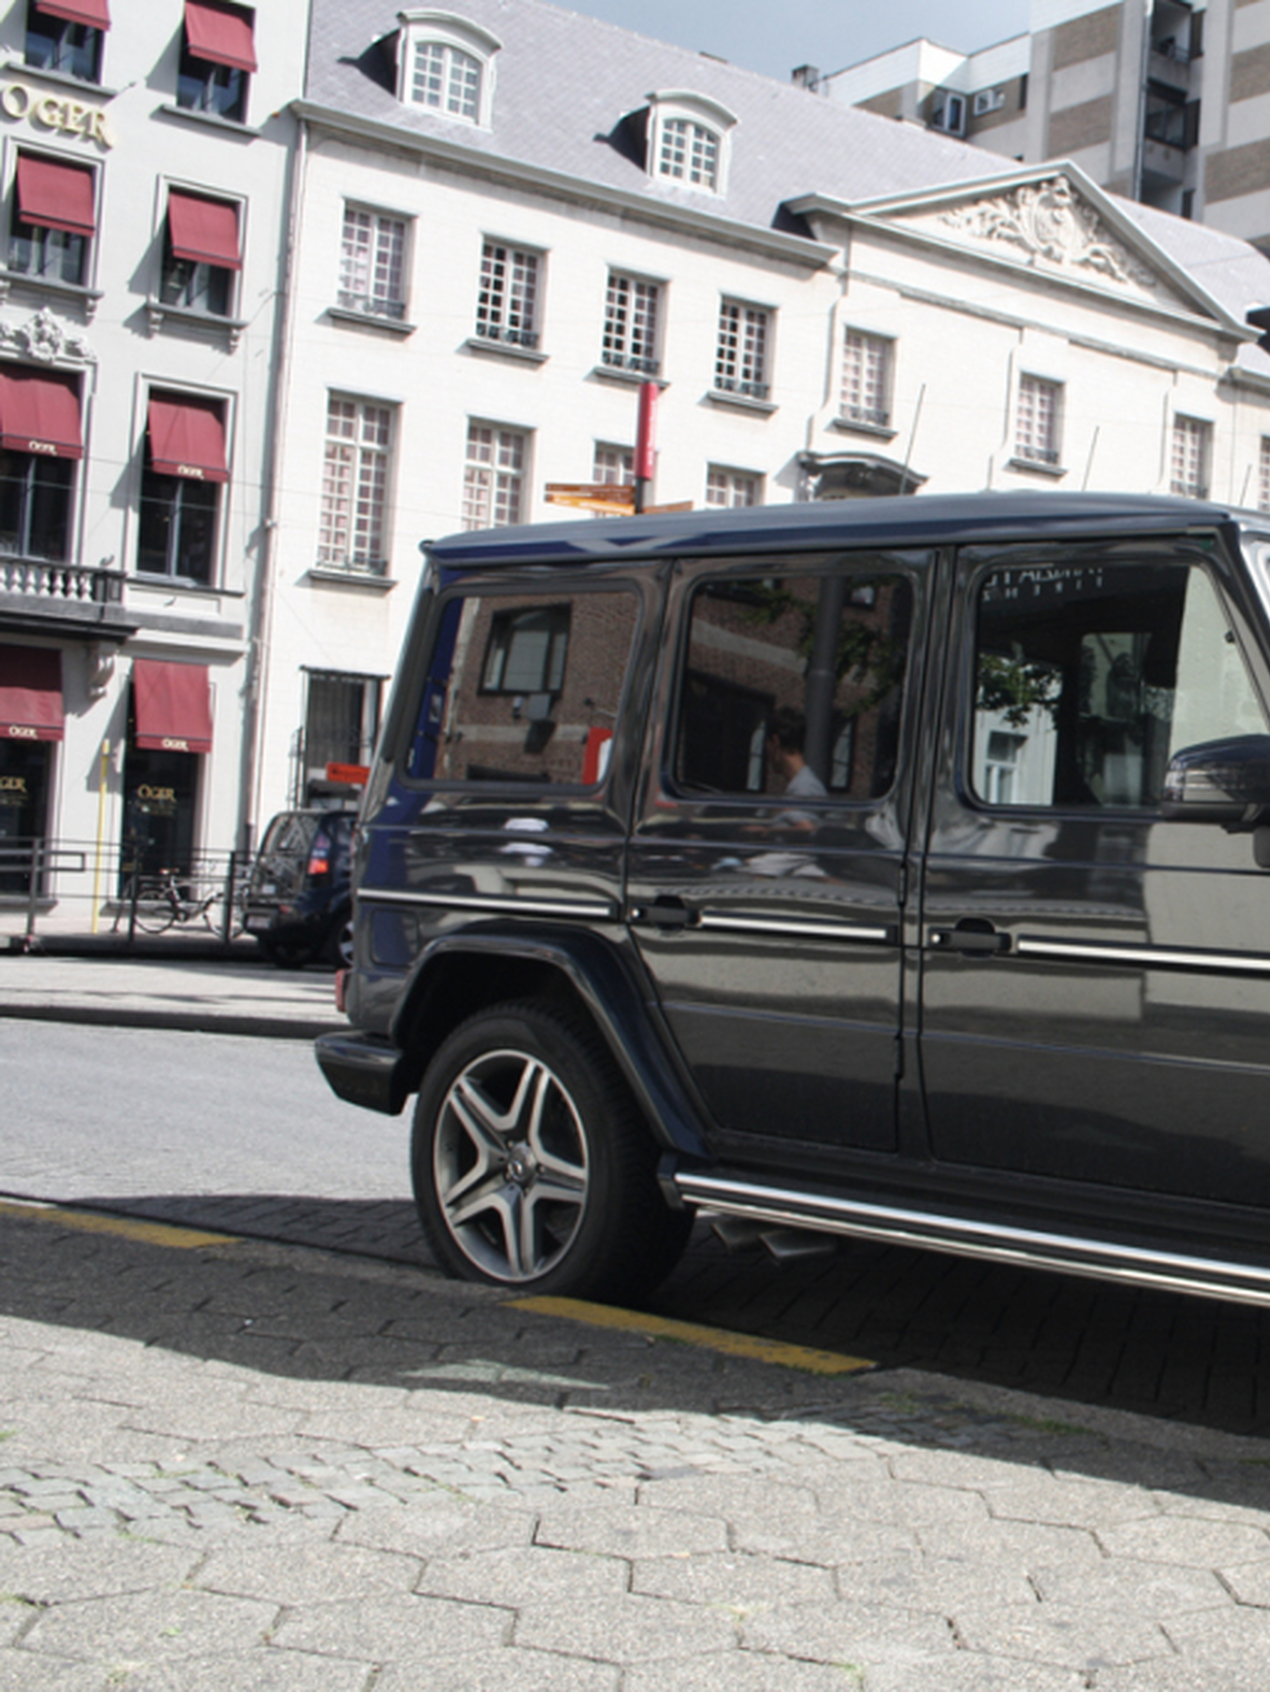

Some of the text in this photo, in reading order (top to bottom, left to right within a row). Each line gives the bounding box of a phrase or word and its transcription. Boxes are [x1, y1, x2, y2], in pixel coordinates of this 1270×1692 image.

[2, 84, 115, 150] OGER
[29, 440, 57, 456] OGER
[177, 465, 204, 480] OGER
[9, 725, 38, 739] OGER
[162, 737, 189, 752] OGER
[0, 776, 28, 794] GER
[138, 784, 177, 802] OGER
